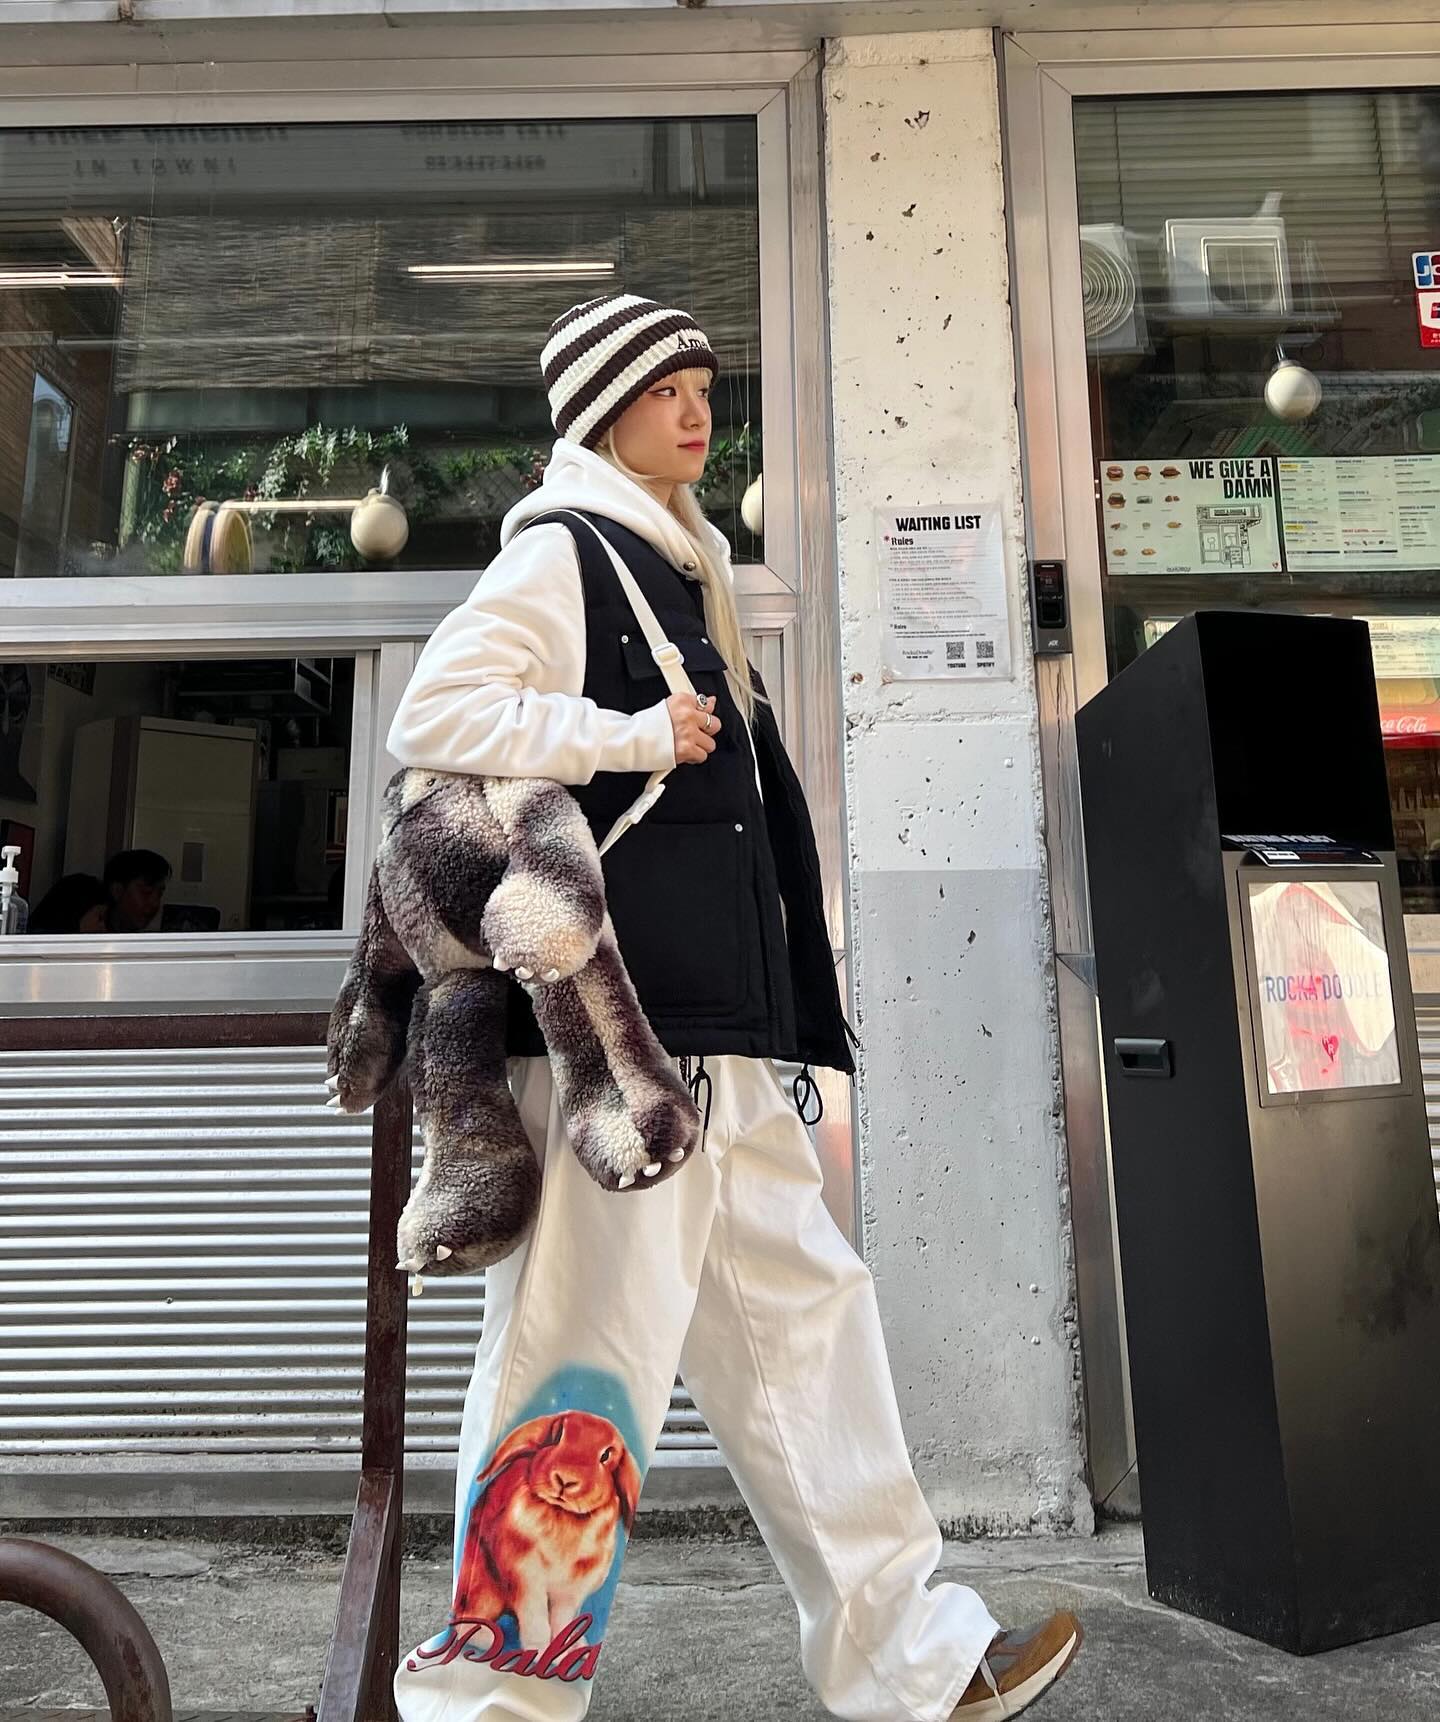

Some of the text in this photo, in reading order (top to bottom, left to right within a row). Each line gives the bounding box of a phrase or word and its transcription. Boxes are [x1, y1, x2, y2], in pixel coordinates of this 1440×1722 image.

[1189, 459, 1271, 479] WE GIVE A
[1223, 478, 1273, 499] DAMN
[895, 515, 982, 532] WAITING LIST
[891, 536, 914, 546] Rules
